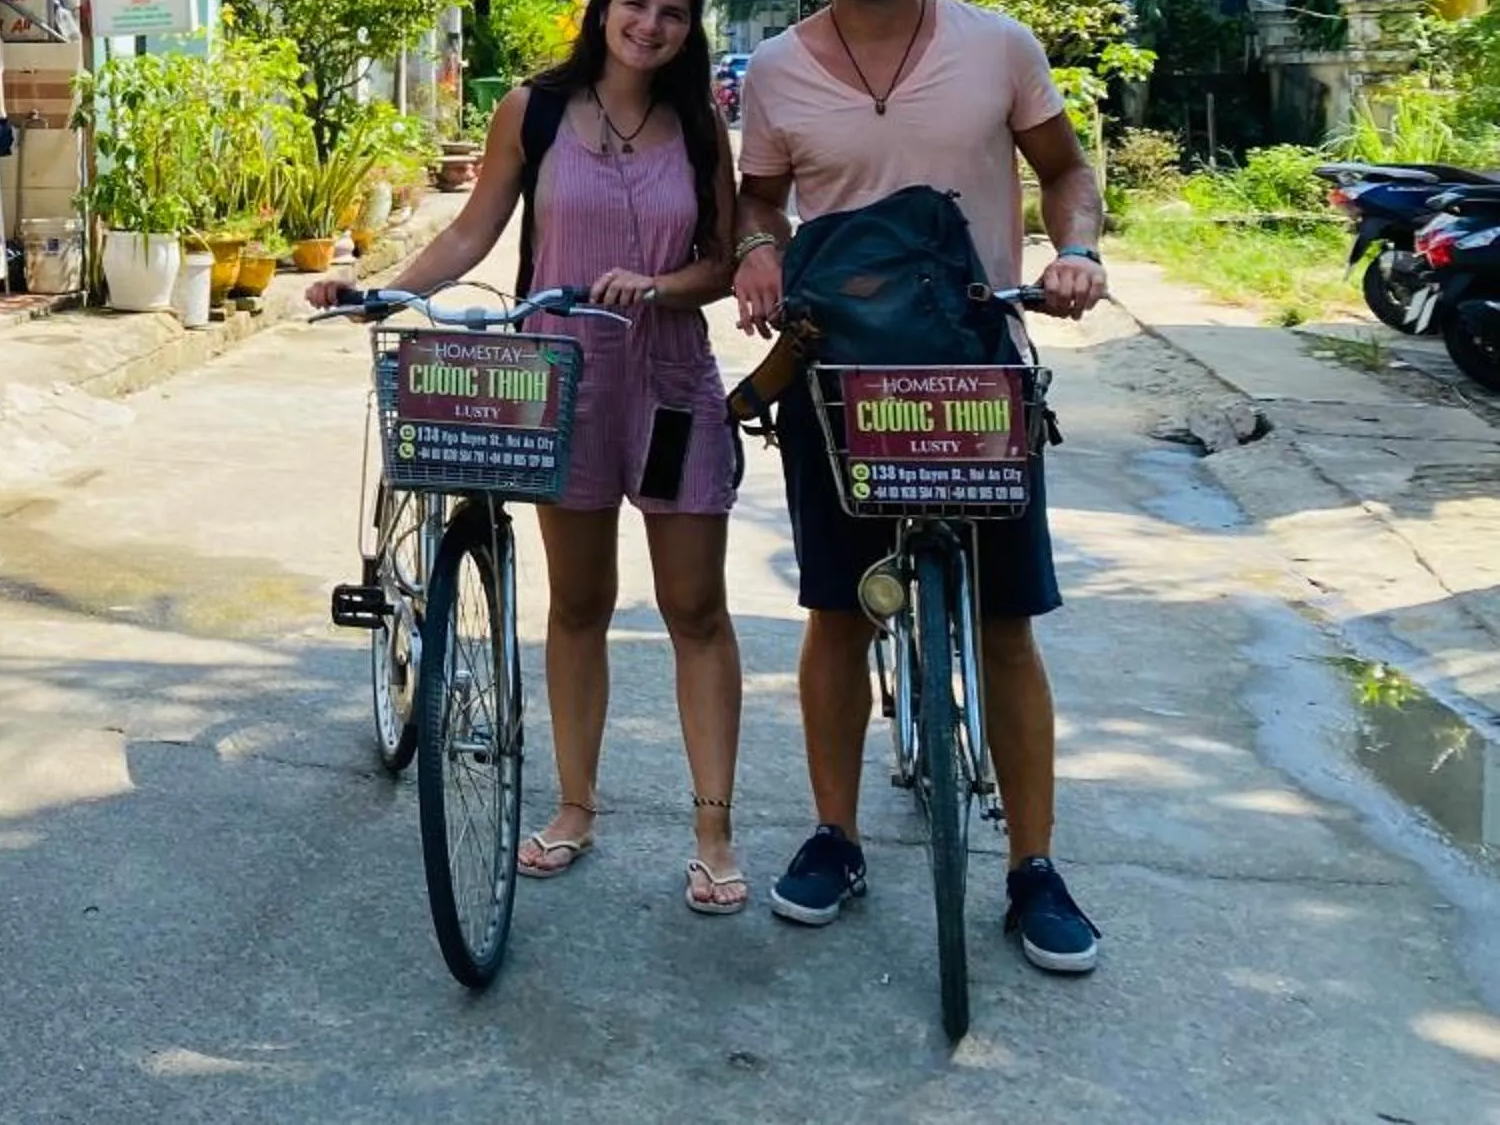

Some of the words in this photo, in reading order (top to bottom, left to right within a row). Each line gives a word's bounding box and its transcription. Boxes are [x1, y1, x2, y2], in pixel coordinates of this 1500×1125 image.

[435, 342, 522, 363] HOMESTAY
[883, 376, 980, 394] HOMESTAY
[455, 405, 501, 420] LUSTY
[910, 440, 962, 453] LUSTY
[871, 465, 897, 481] 138
